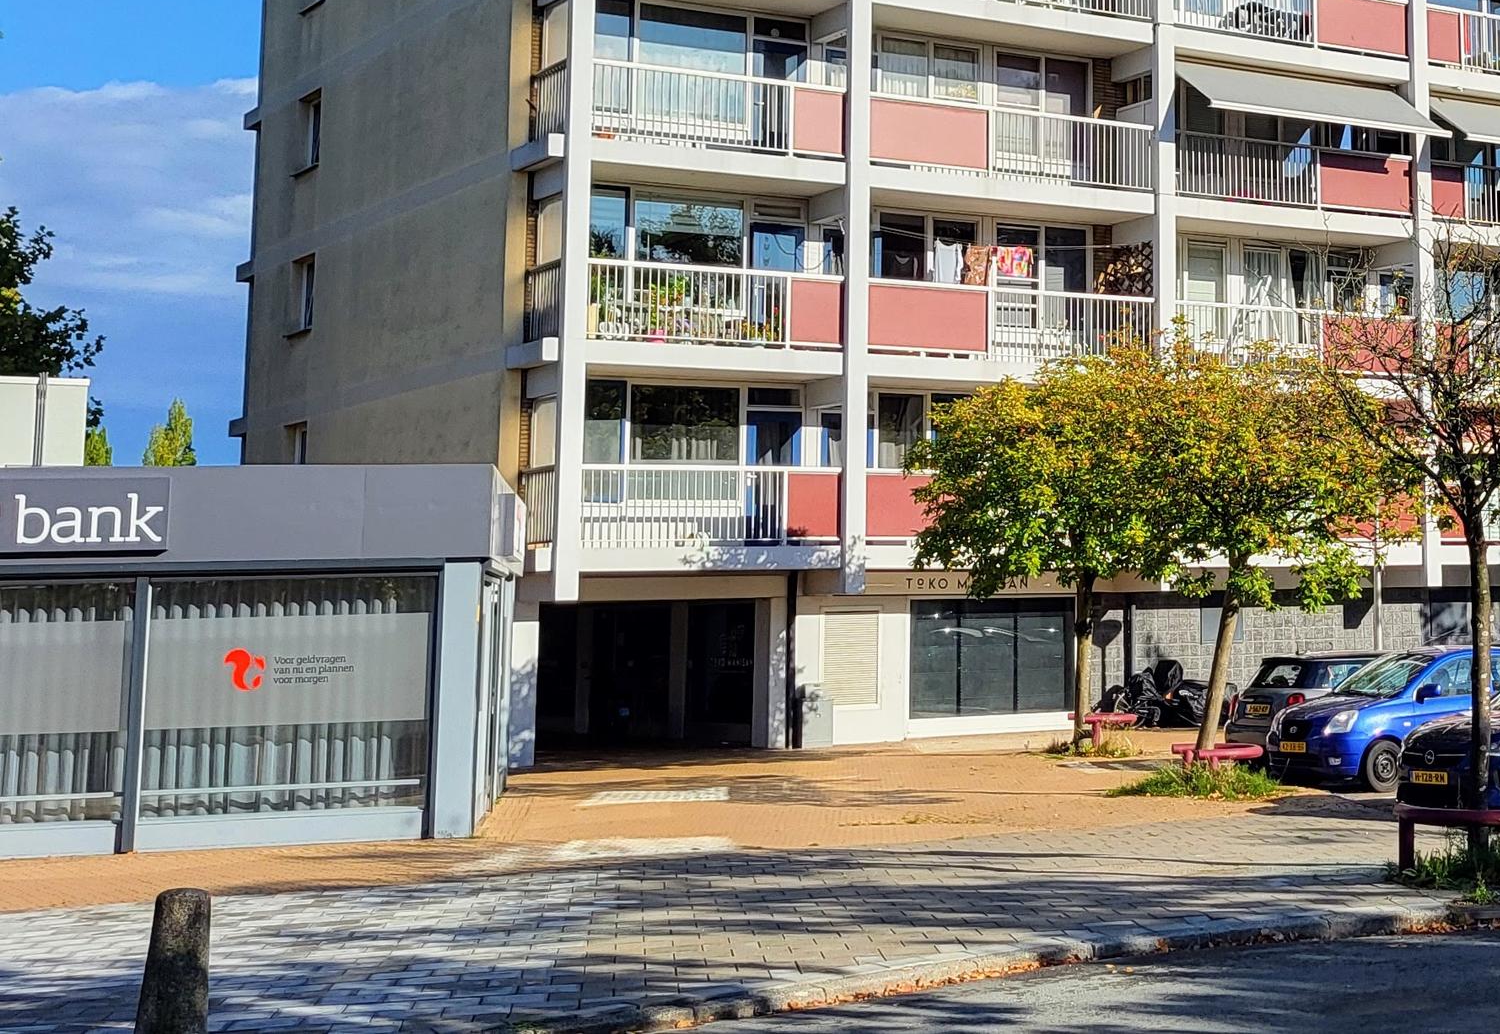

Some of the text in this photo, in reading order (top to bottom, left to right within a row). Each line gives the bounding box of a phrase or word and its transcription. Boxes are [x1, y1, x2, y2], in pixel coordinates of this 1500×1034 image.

[14, 492, 164, 544] bank
[906, 577, 949, 590] TOKO
[274, 655, 346, 665] Voor geldvragen
[292, 666, 304, 674] nu
[305, 666, 317, 674] en
[318, 665, 354, 674] plannen
[294, 676, 329, 684] morgen
